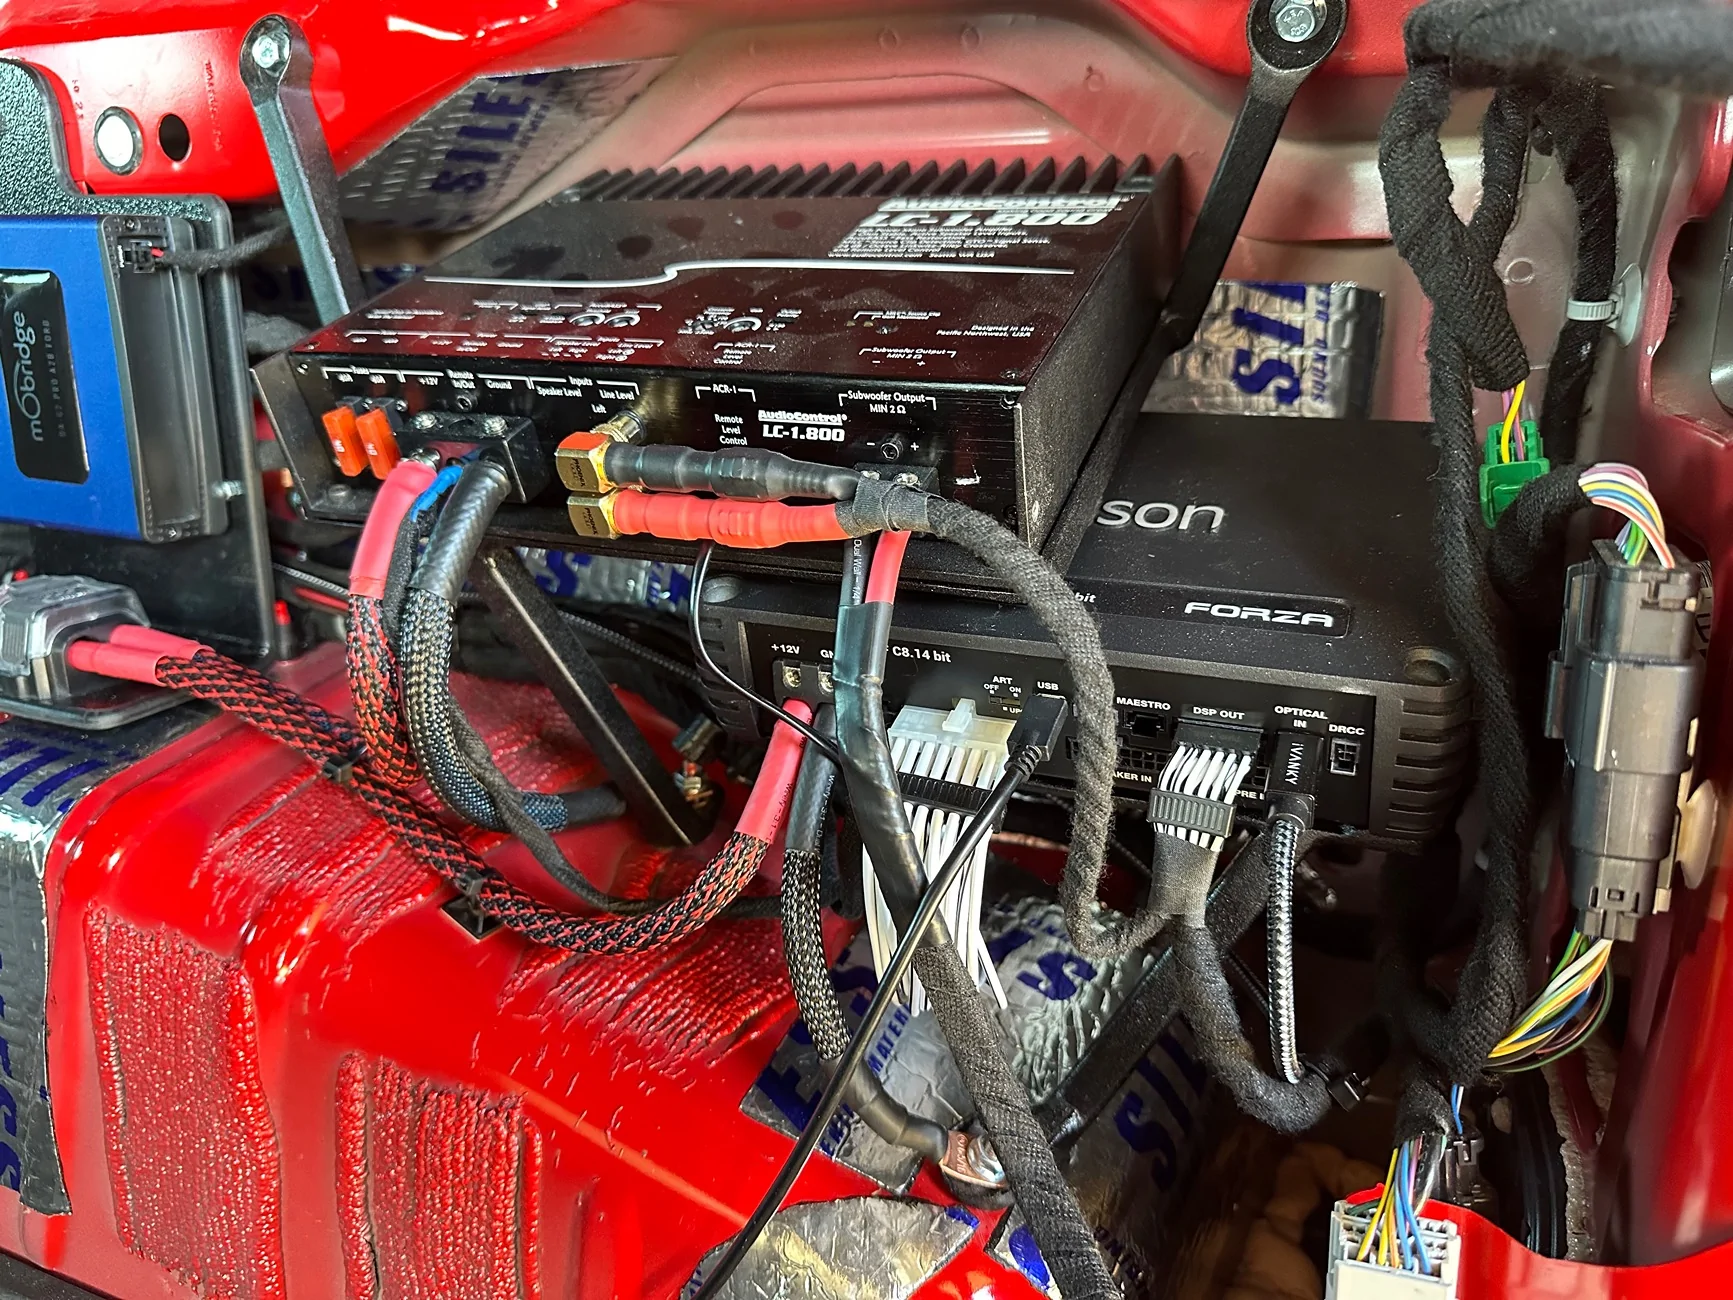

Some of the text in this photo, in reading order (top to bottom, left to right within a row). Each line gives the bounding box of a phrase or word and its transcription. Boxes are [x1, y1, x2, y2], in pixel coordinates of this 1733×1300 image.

[859, 210, 1109, 227] LC-1.800
[447, 369, 475, 380] Remote
[485, 379, 513, 390] Ground
[569, 375, 593, 387] Inputs
[536, 385, 582, 397] Speaker Level
[599, 389, 635, 401] Line Level
[847, 390, 926, 404] Subwoofer Output
[591, 404, 607, 414] Left
[870, 403, 888, 413] MIN
[890, 404, 896, 414] 2
[714, 413, 743, 424] Remote
[722, 424, 741, 435] Level
[762, 424, 845, 442] LC-1.800
[720, 435, 748, 446] Control
[1184, 601, 1334, 628] FORZA
[771, 643, 800, 655] +12V
[892, 645, 931, 660] C8.14
[933, 649, 952, 663] bit
[992, 675, 1013, 685] ART
[1037, 681, 1059, 691] USB
[983, 683, 1022, 694] OFF ON
[1116, 697, 1171, 711] MAESTRO
[1193, 707, 1245, 720] DSP OUT
[1274, 705, 1328, 720] OPTICAL
[1293, 719, 1307, 729] IN
[1328, 723, 1365, 736] DRCC
[1140, 774, 1152, 782] IN
